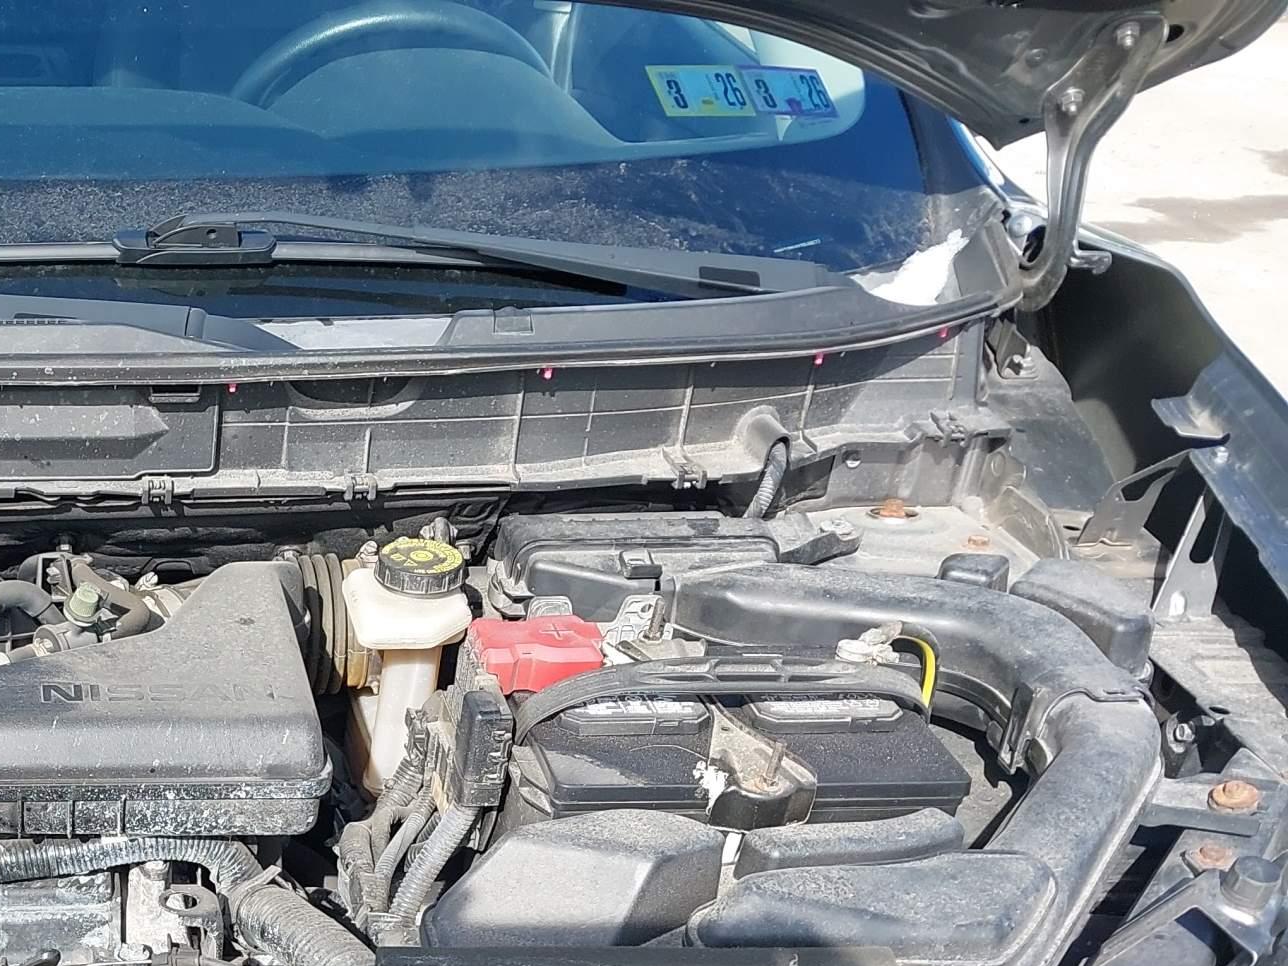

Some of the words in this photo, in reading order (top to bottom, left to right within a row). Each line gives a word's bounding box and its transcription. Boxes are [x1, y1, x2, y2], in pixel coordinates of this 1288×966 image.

[666, 79, 689, 109] 3
[714, 72, 747, 107] 26
[754, 79, 778, 109] 3
[799, 74, 830, 109] 26
[40, 680, 278, 704] NISSAN
